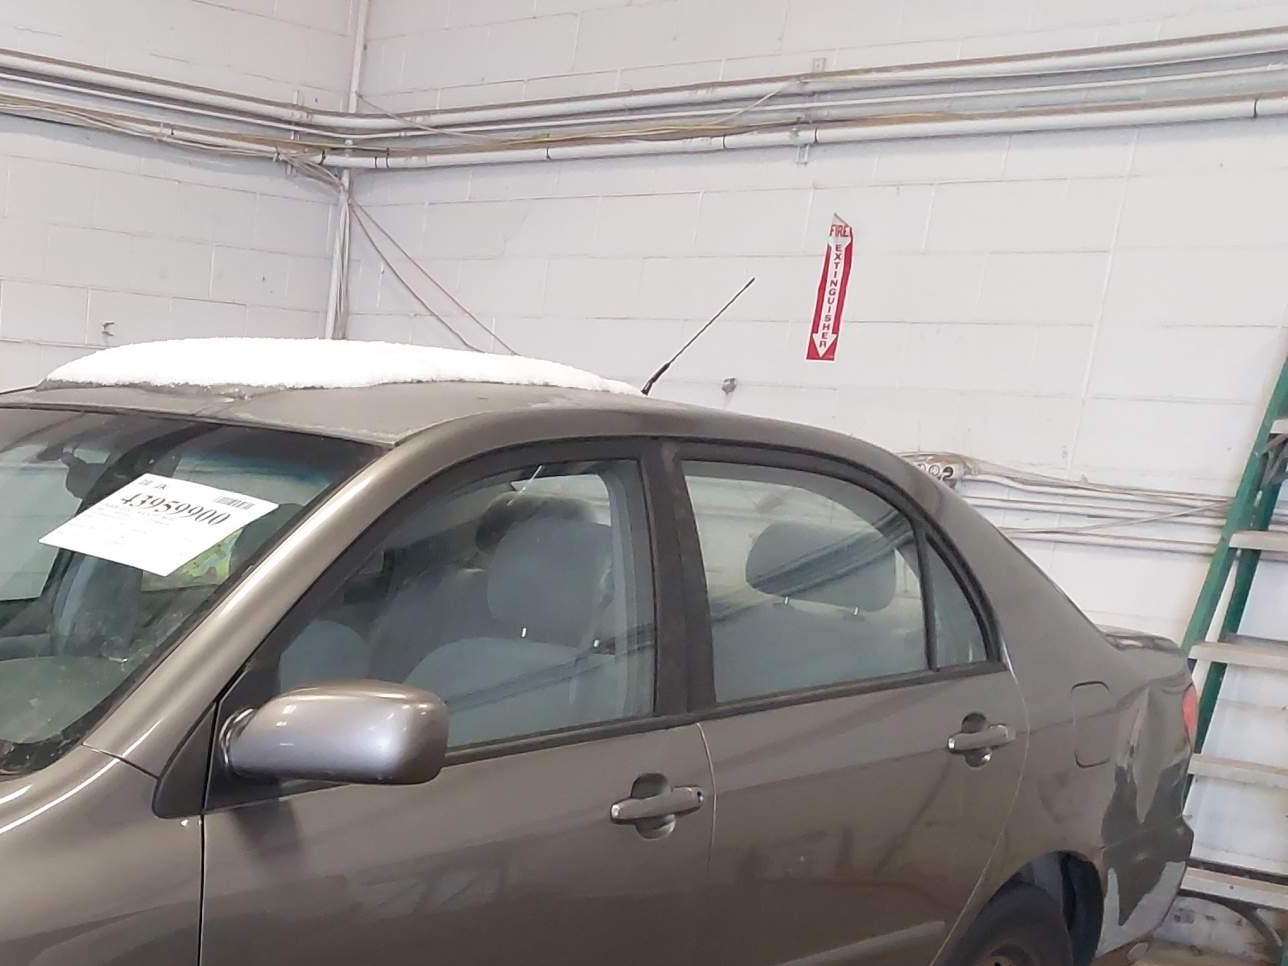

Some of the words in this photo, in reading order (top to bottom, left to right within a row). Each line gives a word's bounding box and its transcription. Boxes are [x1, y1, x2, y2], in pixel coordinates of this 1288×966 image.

[829, 224, 849, 237] FIRE
[819, 244, 843, 349] EXTINGUISHER
[120, 491, 232, 526] 43959900
